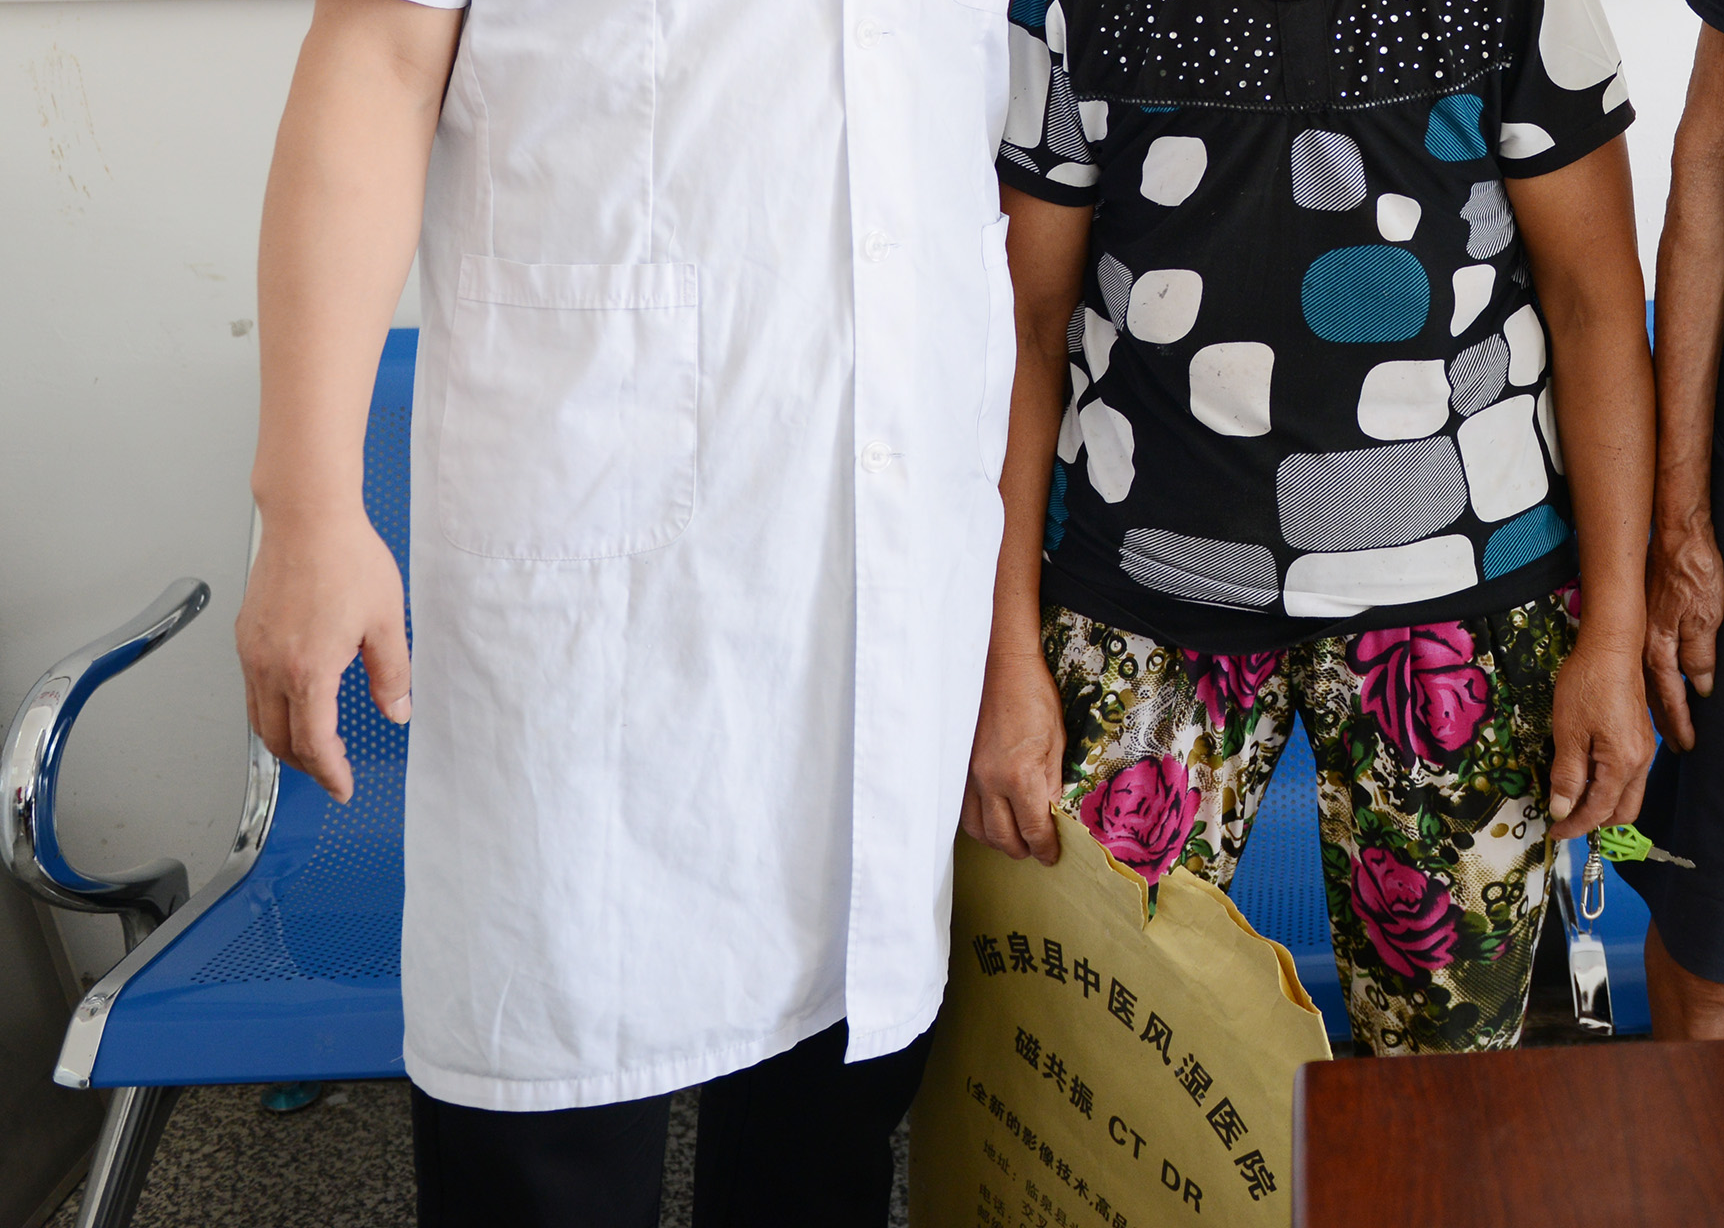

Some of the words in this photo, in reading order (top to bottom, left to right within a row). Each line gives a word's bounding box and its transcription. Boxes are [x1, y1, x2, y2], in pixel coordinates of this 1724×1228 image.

[973, 930, 1277, 1201] 临泉县中医风湿医院
[1014, 1026, 1094, 1120] 磁共振
[1108, 1115, 1147, 1160] CT
[1160, 1159, 1203, 1213] DR
